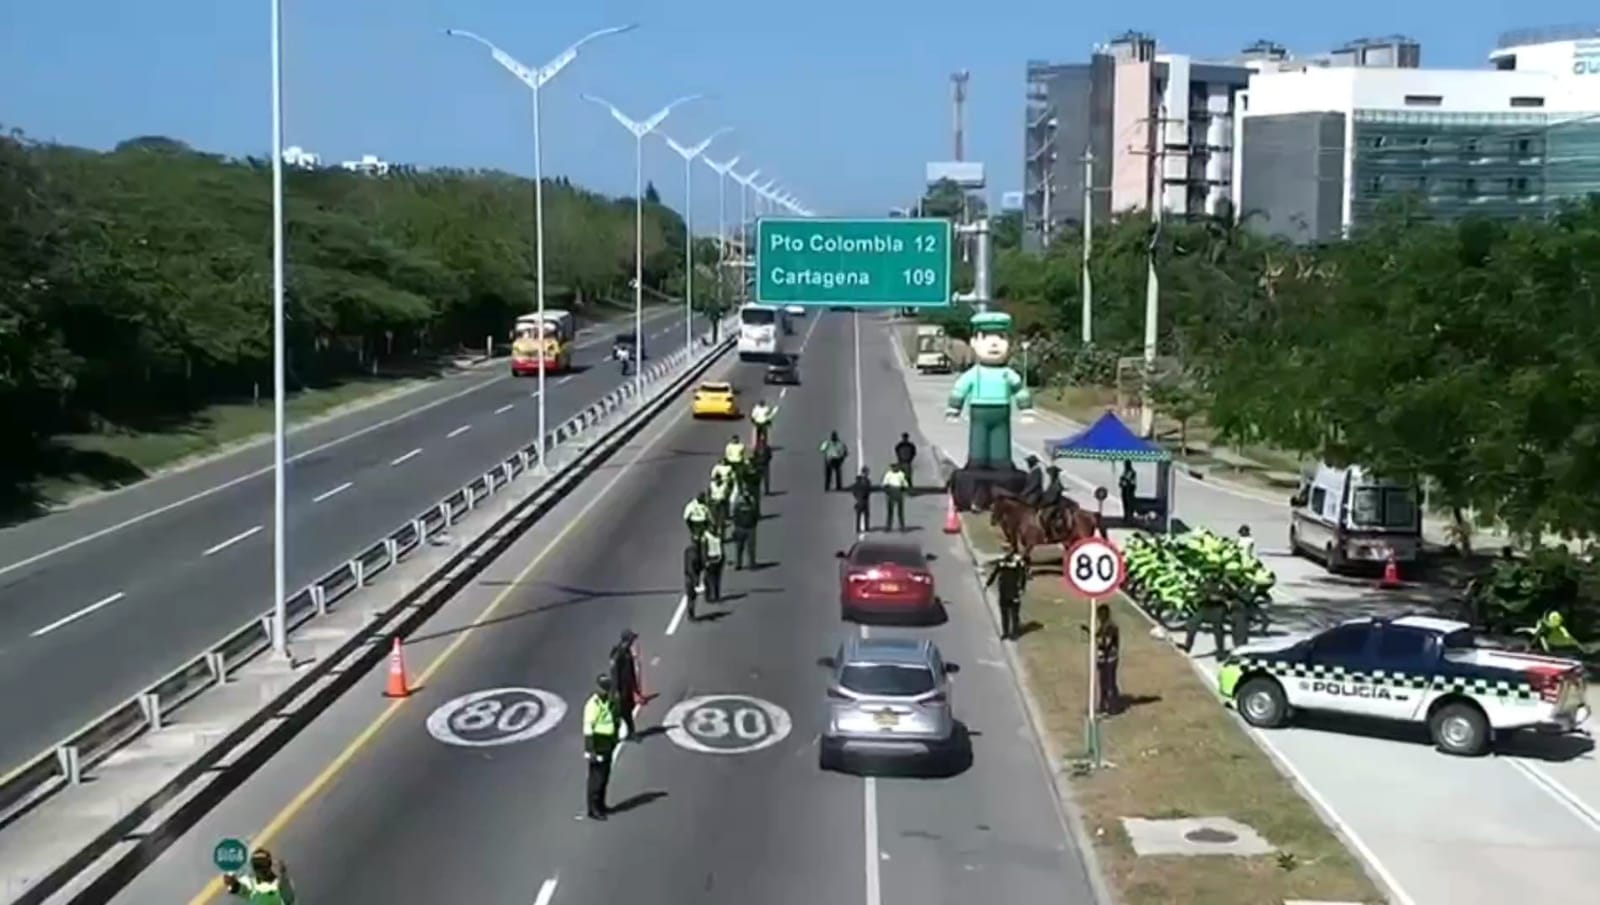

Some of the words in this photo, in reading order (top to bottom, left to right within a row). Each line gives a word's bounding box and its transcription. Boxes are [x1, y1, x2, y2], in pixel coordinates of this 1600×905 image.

[771, 234, 804, 252] Pto
[810, 234, 904, 252] Colombia
[915, 235, 937, 252] 12
[771, 267, 869, 288] Cartagena
[903, 268, 937, 286] 109
[1076, 554, 1114, 581] 80
[454, 700, 541, 732] 80
[690, 708, 767, 739] 80
